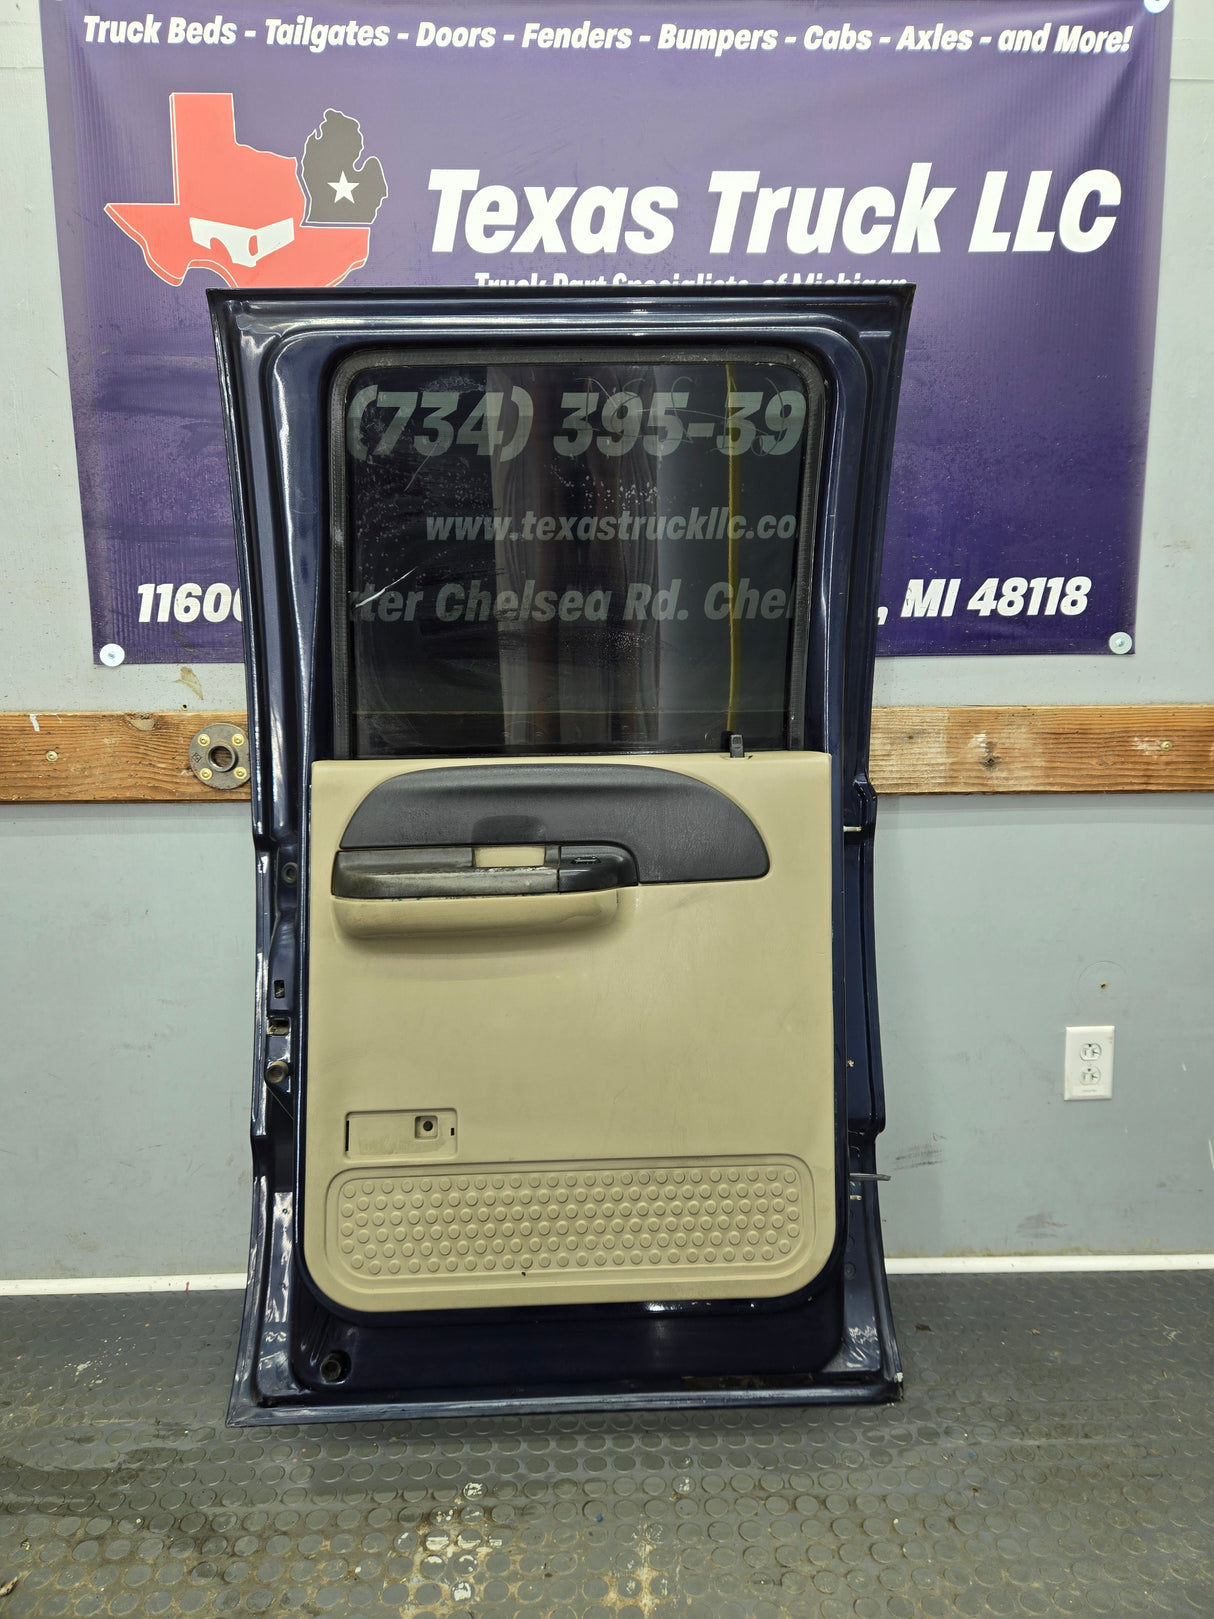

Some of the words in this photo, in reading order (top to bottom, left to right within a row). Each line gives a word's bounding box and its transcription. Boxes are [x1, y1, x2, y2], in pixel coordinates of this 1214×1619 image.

[83, 14, 162, 44] Truck
[168, 15, 237, 45] Beds
[264, 15, 390, 53] Tailgates
[416, 21, 497, 48] Doors
[521, 20, 632, 49] Fenders
[657, 23, 778, 56] Bumpers
[803, 23, 873, 51] Cabs
[895, 22, 973, 51] Axles
[998, 23, 1052, 53] and
[1052, 25, 1134, 54] More!
[427, 168, 679, 254] Texas
[707, 162, 957, 254] Truck
[967, 169, 1122, 253] LLC
[347, 384, 534, 462] (734)
[553, 390, 807, 457] 395-39
[426, 506, 797, 541] www.texastruckllc.co
[137, 582, 243, 623] 1160
[349, 582, 424, 622] ter
[435, 579, 612, 622] Chelsea
[623, 578, 689, 621] Rd.
[900, 578, 962, 618] MI
[966, 576, 1092, 617] 48118
